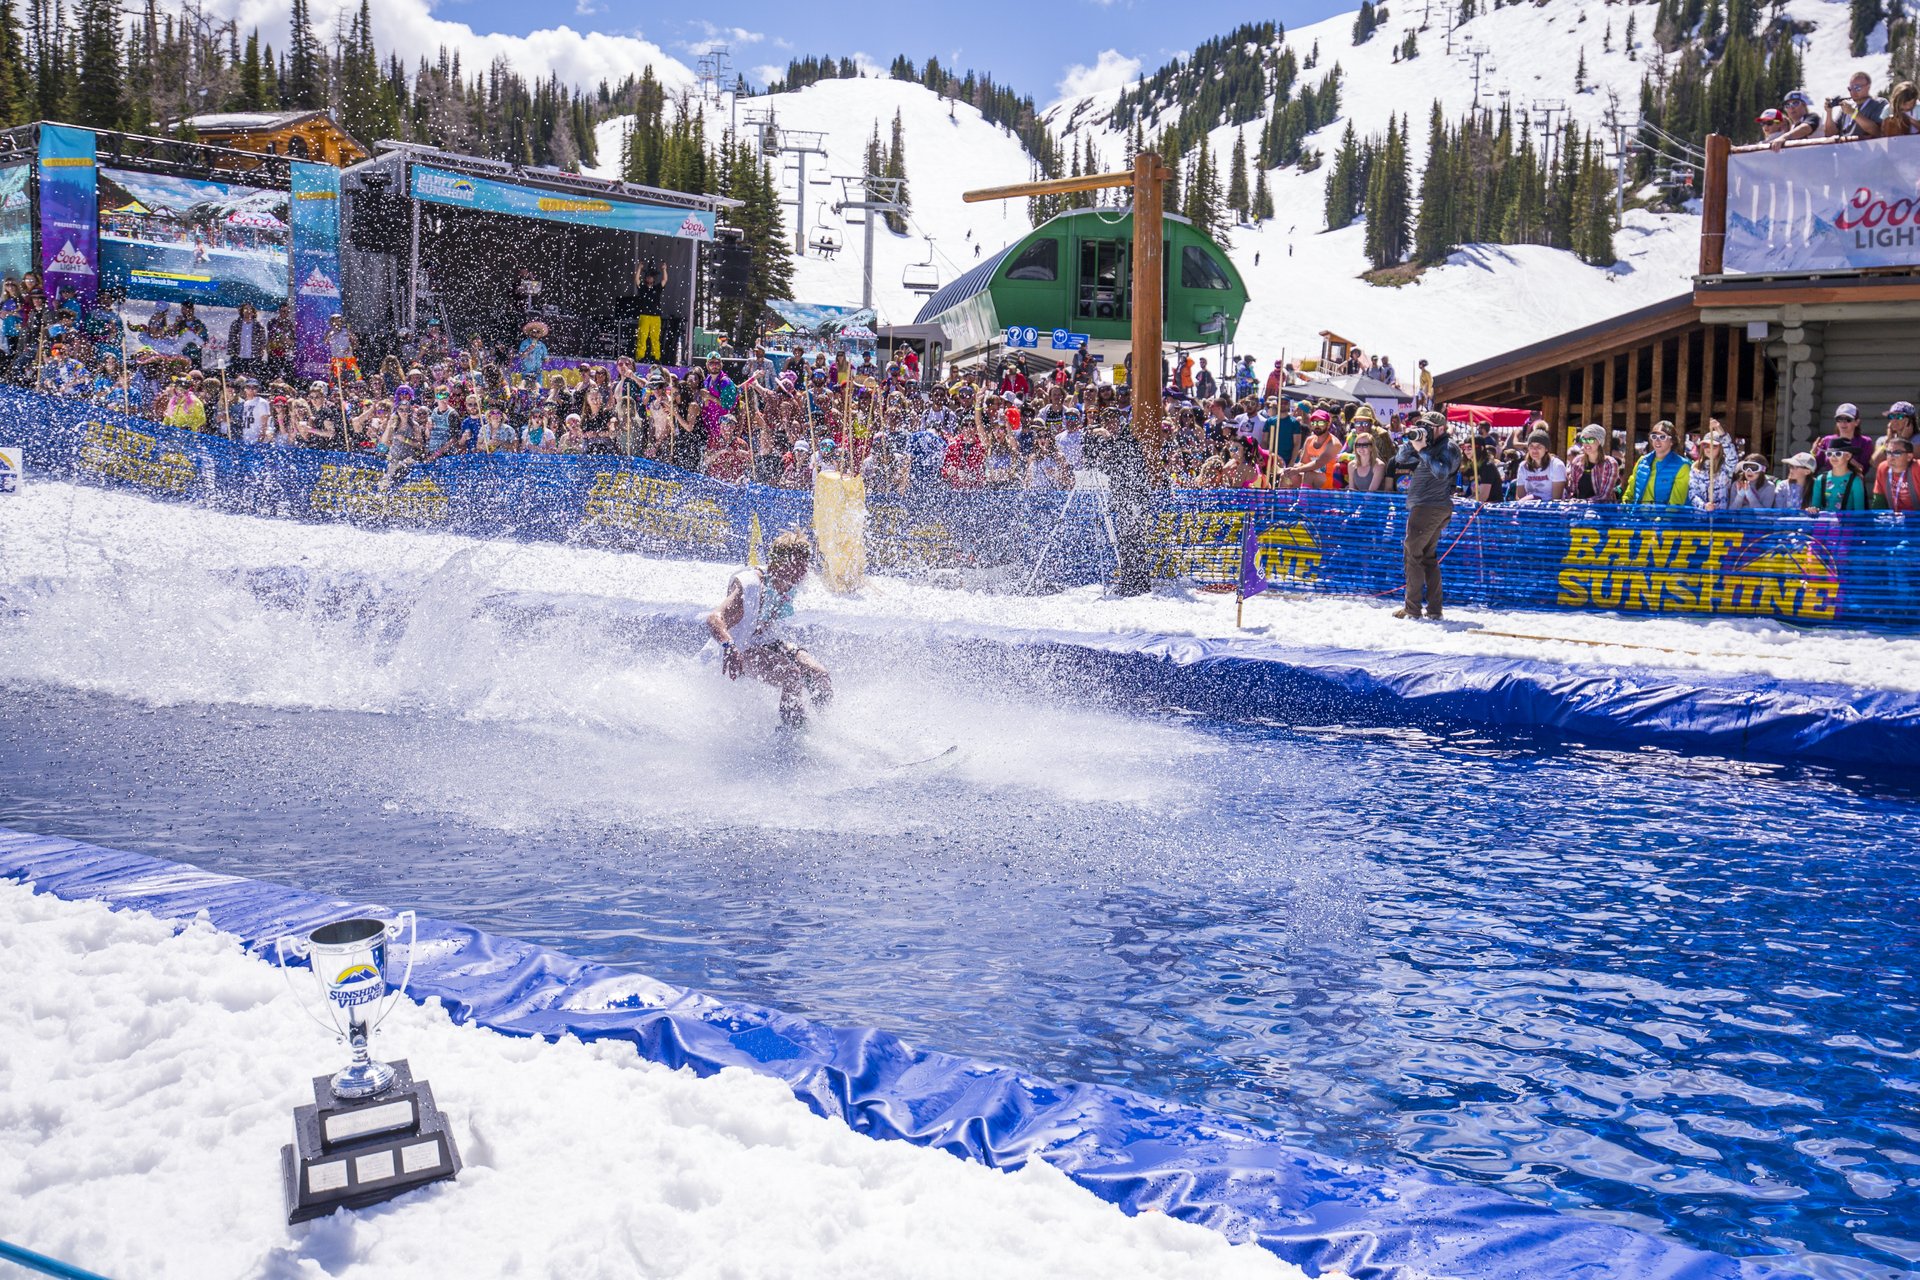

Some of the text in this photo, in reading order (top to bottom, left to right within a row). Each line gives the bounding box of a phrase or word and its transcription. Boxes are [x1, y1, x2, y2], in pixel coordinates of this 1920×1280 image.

[1835, 187, 1920, 229] Coo
[682, 219, 706, 232] Coors
[1856, 226, 1920, 248] LIGH
[55, 250, 87, 265] Coors
[60, 263, 81, 271] LIGHT
[1561, 528, 1744, 569] BANFF
[1557, 568, 1839, 620] SUNSHINE
[330, 981, 381, 1000] SUNSHINE
